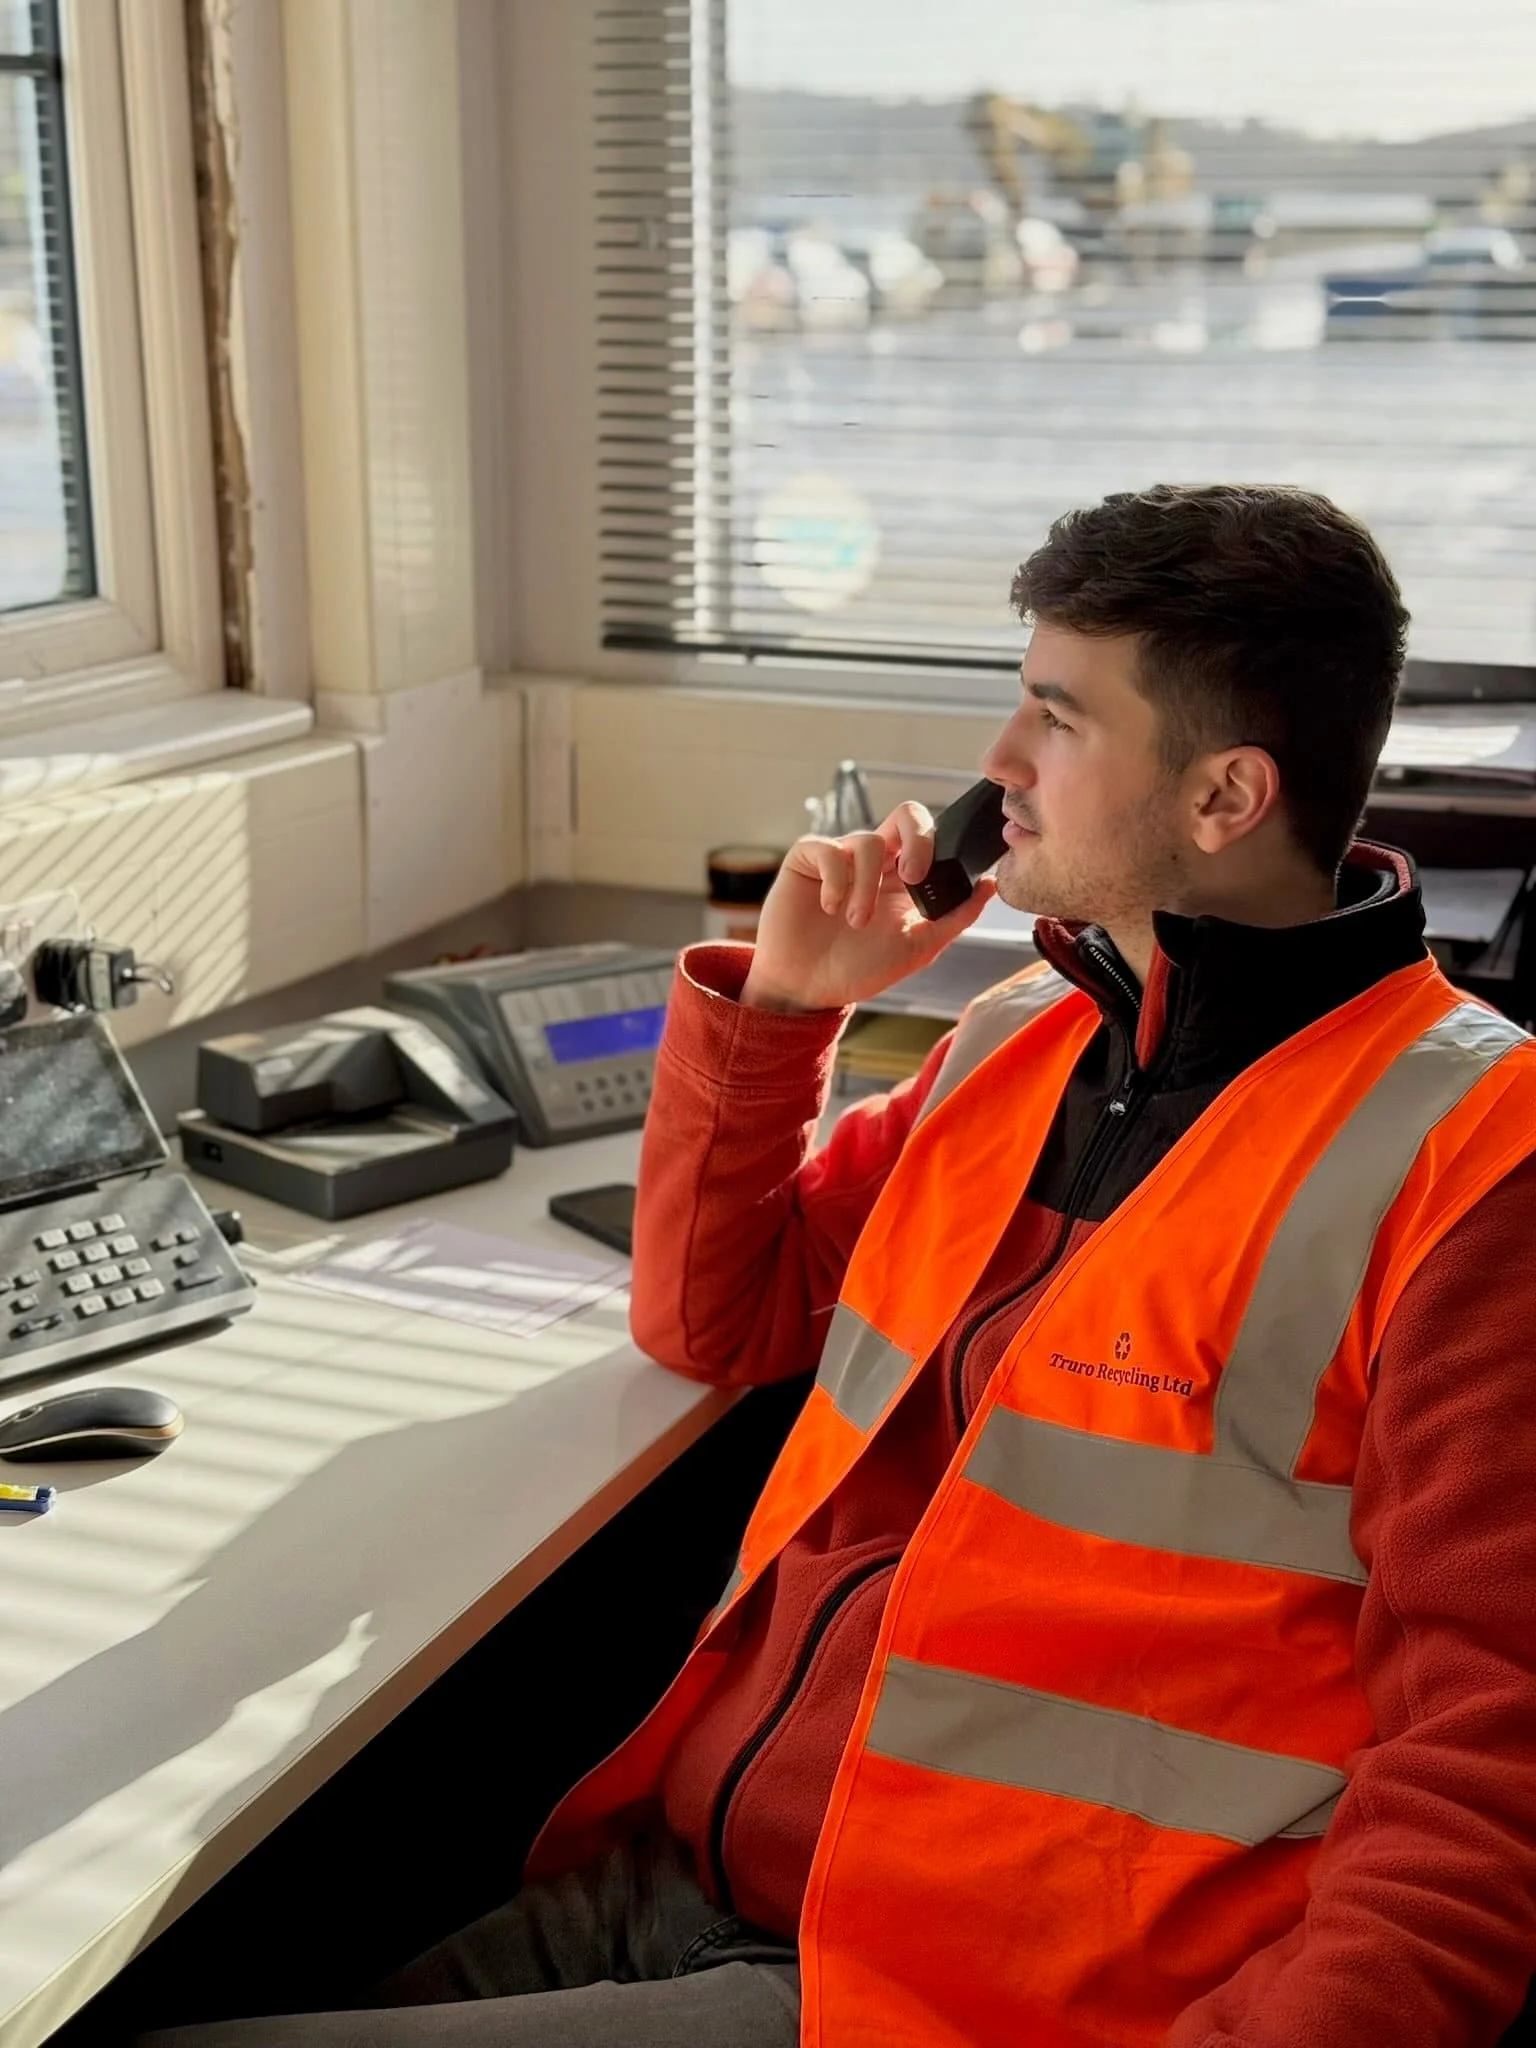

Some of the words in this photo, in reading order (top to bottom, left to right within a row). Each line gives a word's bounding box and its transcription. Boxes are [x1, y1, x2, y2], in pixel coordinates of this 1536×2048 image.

[1050, 1353, 1095, 1377] Truro
[1097, 1363, 1161, 1393] Recycling
[1163, 1375, 1194, 1396] Ltd
